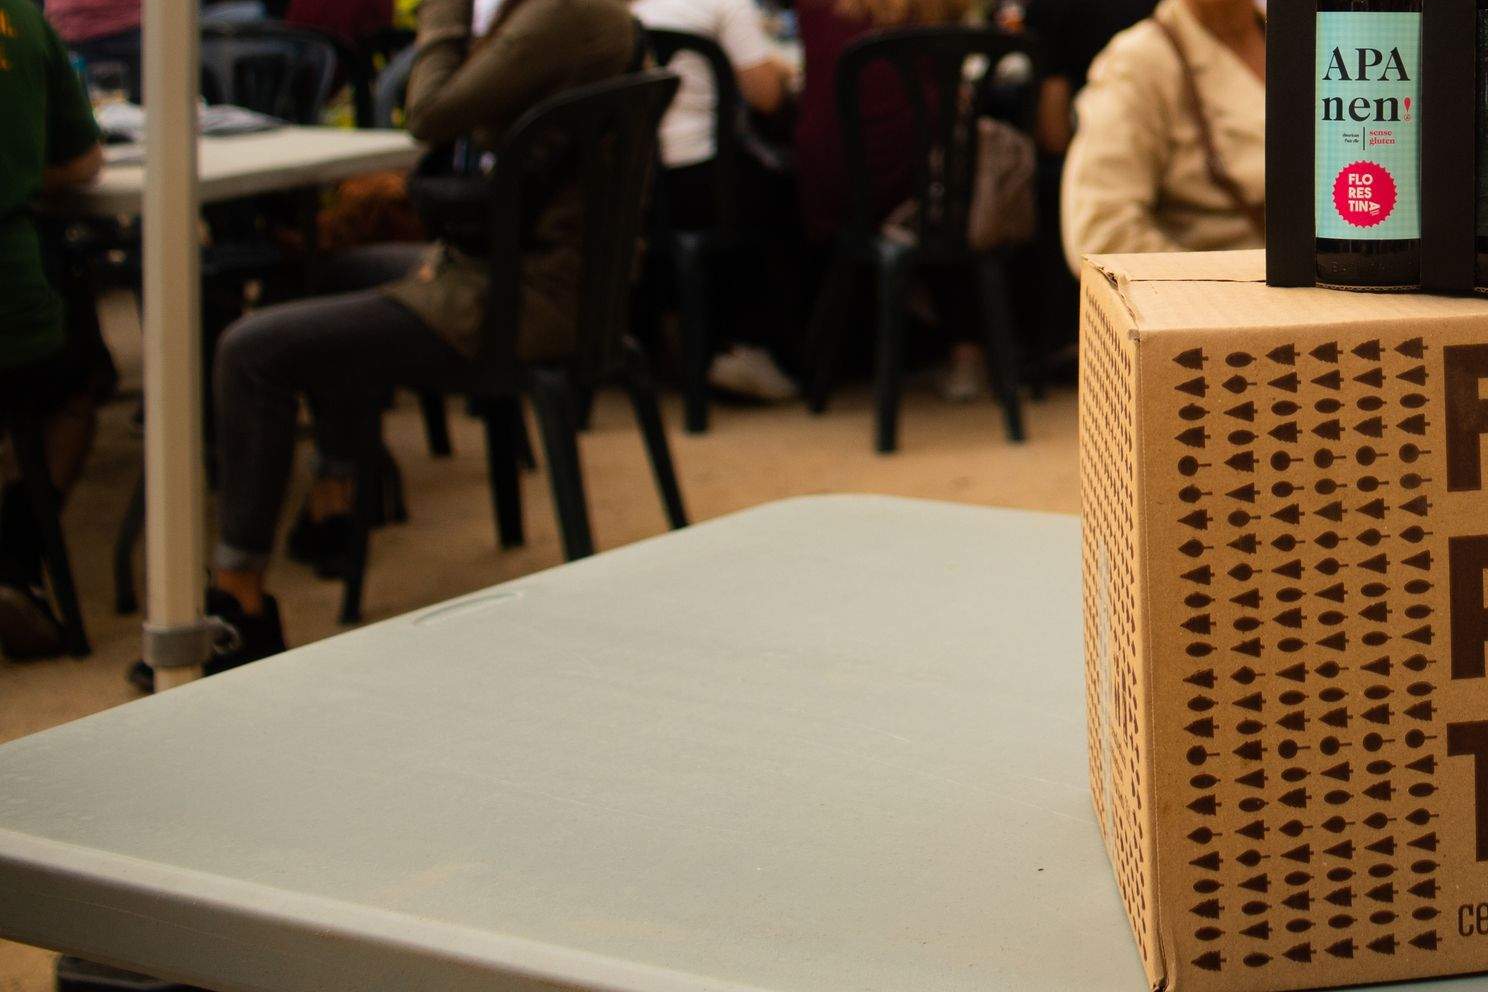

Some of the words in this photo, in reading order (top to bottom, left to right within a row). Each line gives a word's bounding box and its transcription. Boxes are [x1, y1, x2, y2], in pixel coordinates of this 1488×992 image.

[1321, 45, 1411, 82] APA
[1369, 137, 1396, 146] gluten
[1348, 173, 1374, 186] FLO
[1348, 186, 1373, 199] RES
[1347, 200, 1381, 213] TINA
